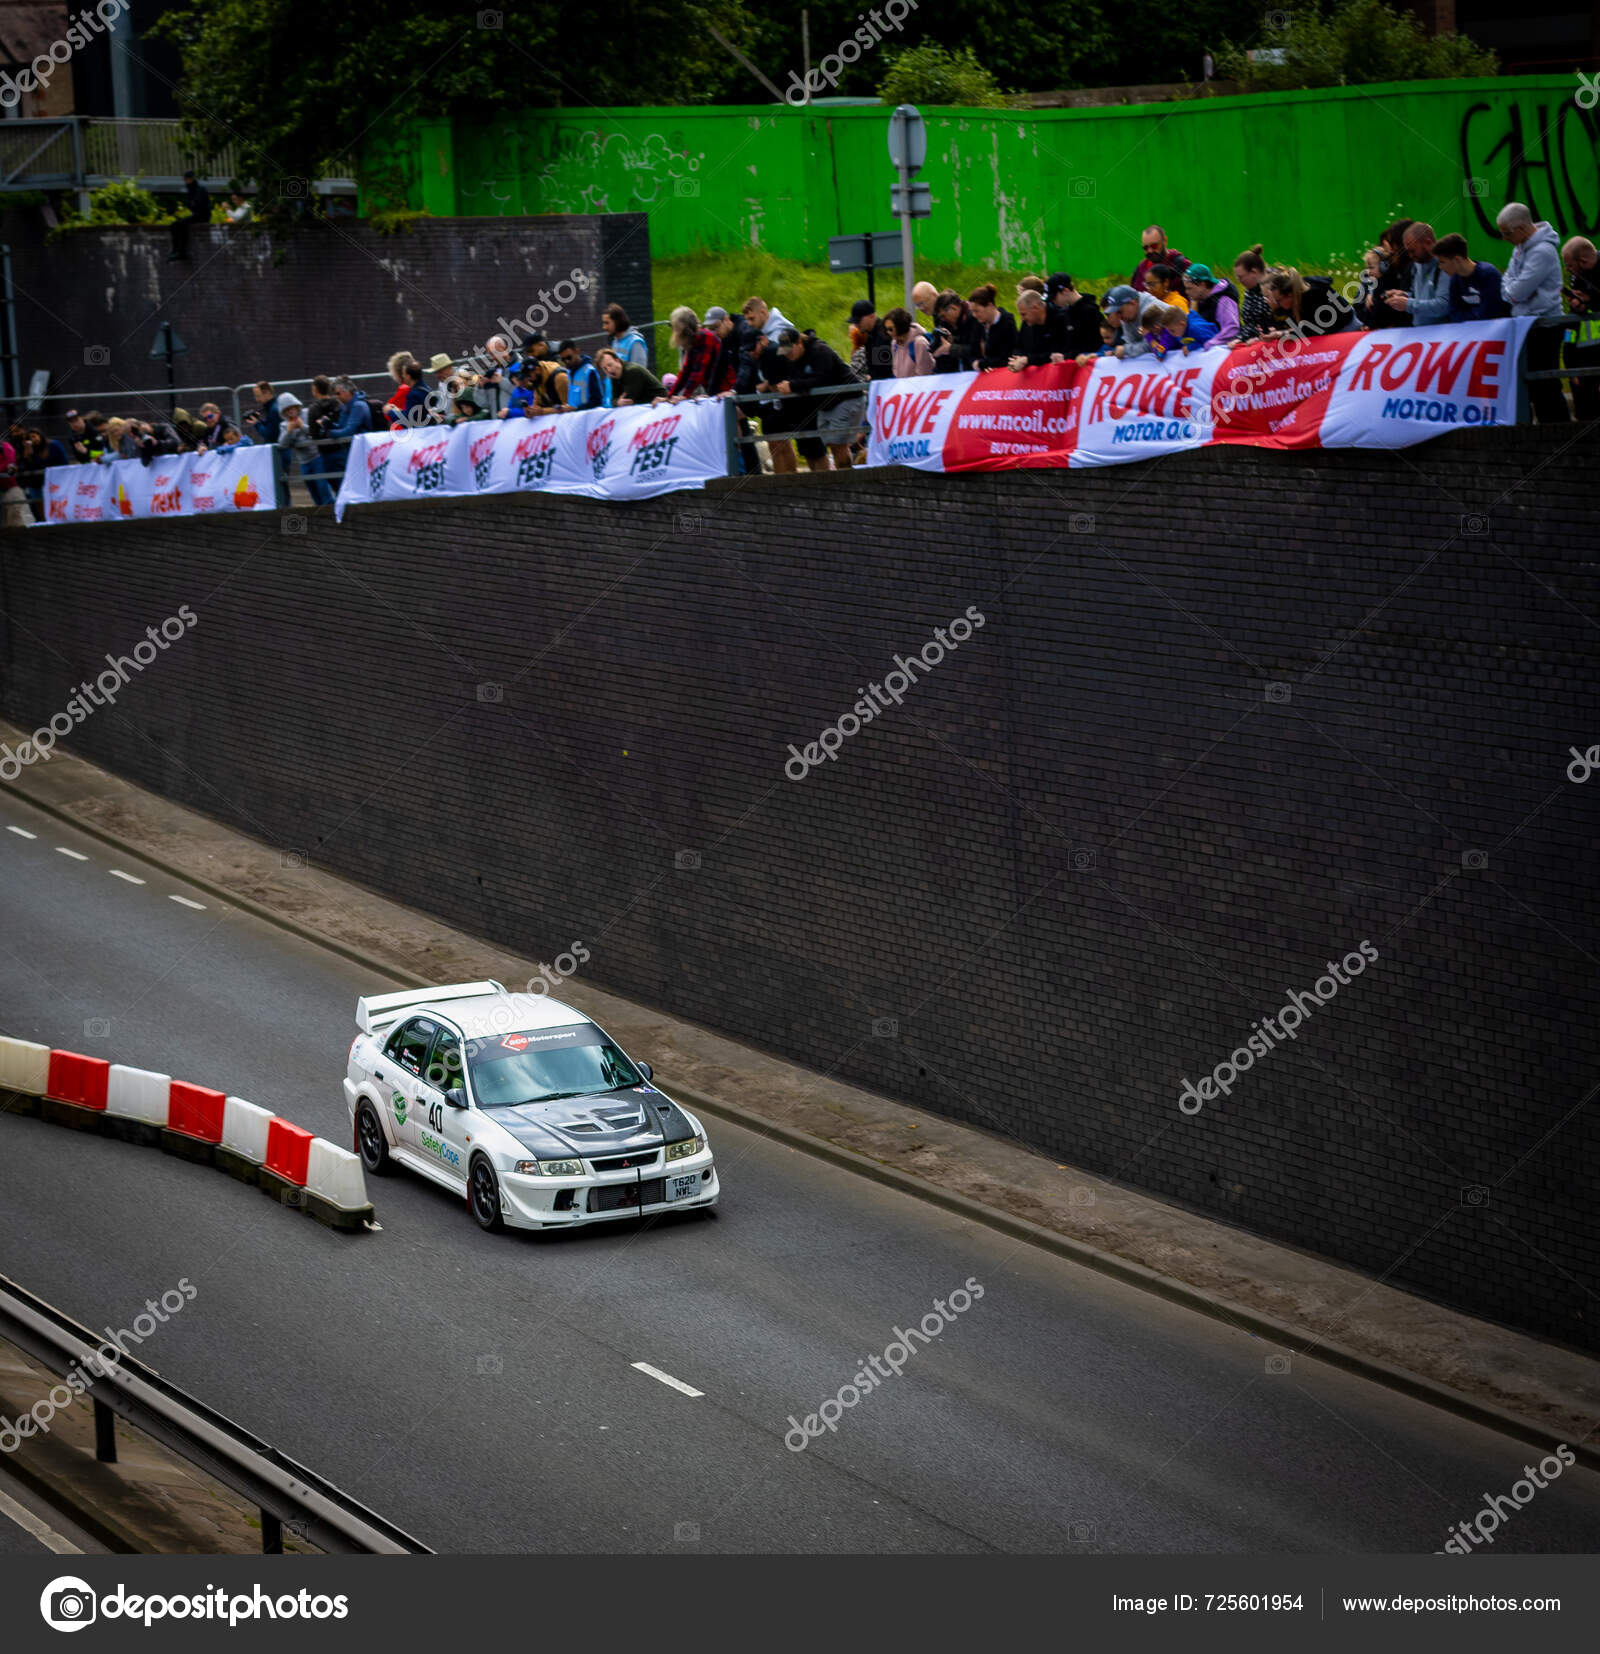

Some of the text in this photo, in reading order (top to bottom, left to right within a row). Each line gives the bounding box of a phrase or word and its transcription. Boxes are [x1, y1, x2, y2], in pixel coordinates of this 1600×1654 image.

[1347, 341, 1506, 399] ROWE
[1088, 368, 1202, 425] ROWE
[1382, 398, 1457, 423] MOTOR
[510, 425, 557, 464] MOTO
[627, 414, 682, 453] MOTO
[1112, 423, 1164, 444] MOTOR
[515, 447, 557, 487] FEST
[630, 436, 679, 476] FEST
[412, 458, 447, 494] FEST
[528, 1031, 577, 1043] Motorsport
[428, 1101, 443, 1135] 40
[421, 1131, 460, 1166] SafetyCope
[672, 1174, 696, 1189] T620
